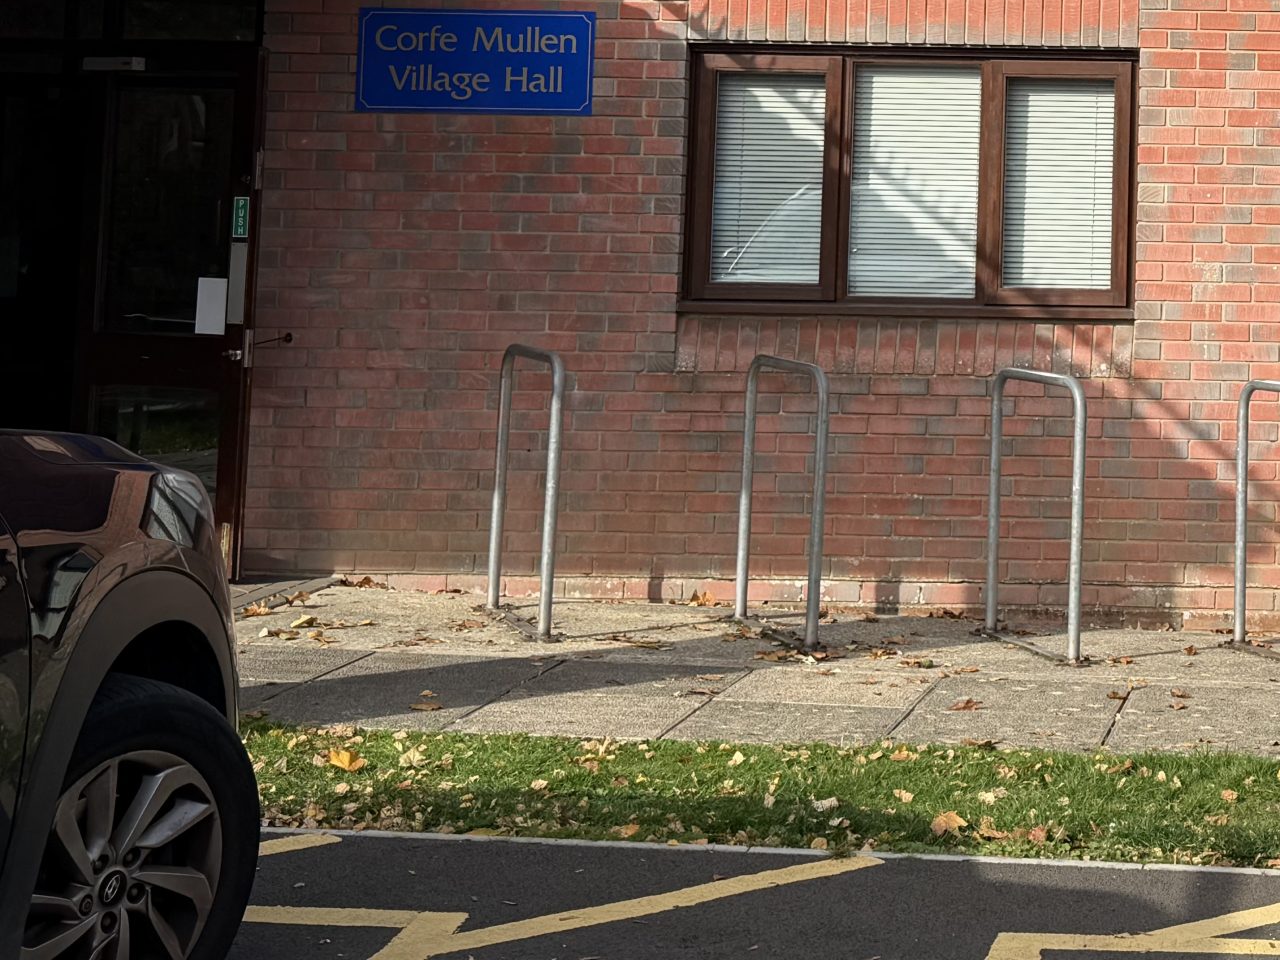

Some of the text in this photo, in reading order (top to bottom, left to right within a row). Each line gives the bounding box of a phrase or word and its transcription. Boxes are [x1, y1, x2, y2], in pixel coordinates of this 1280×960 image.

[375, 25, 577, 54] Corfe Mullen
[388, 64, 563, 100] Village Hall
[237, 199, 245, 235] PUSH
